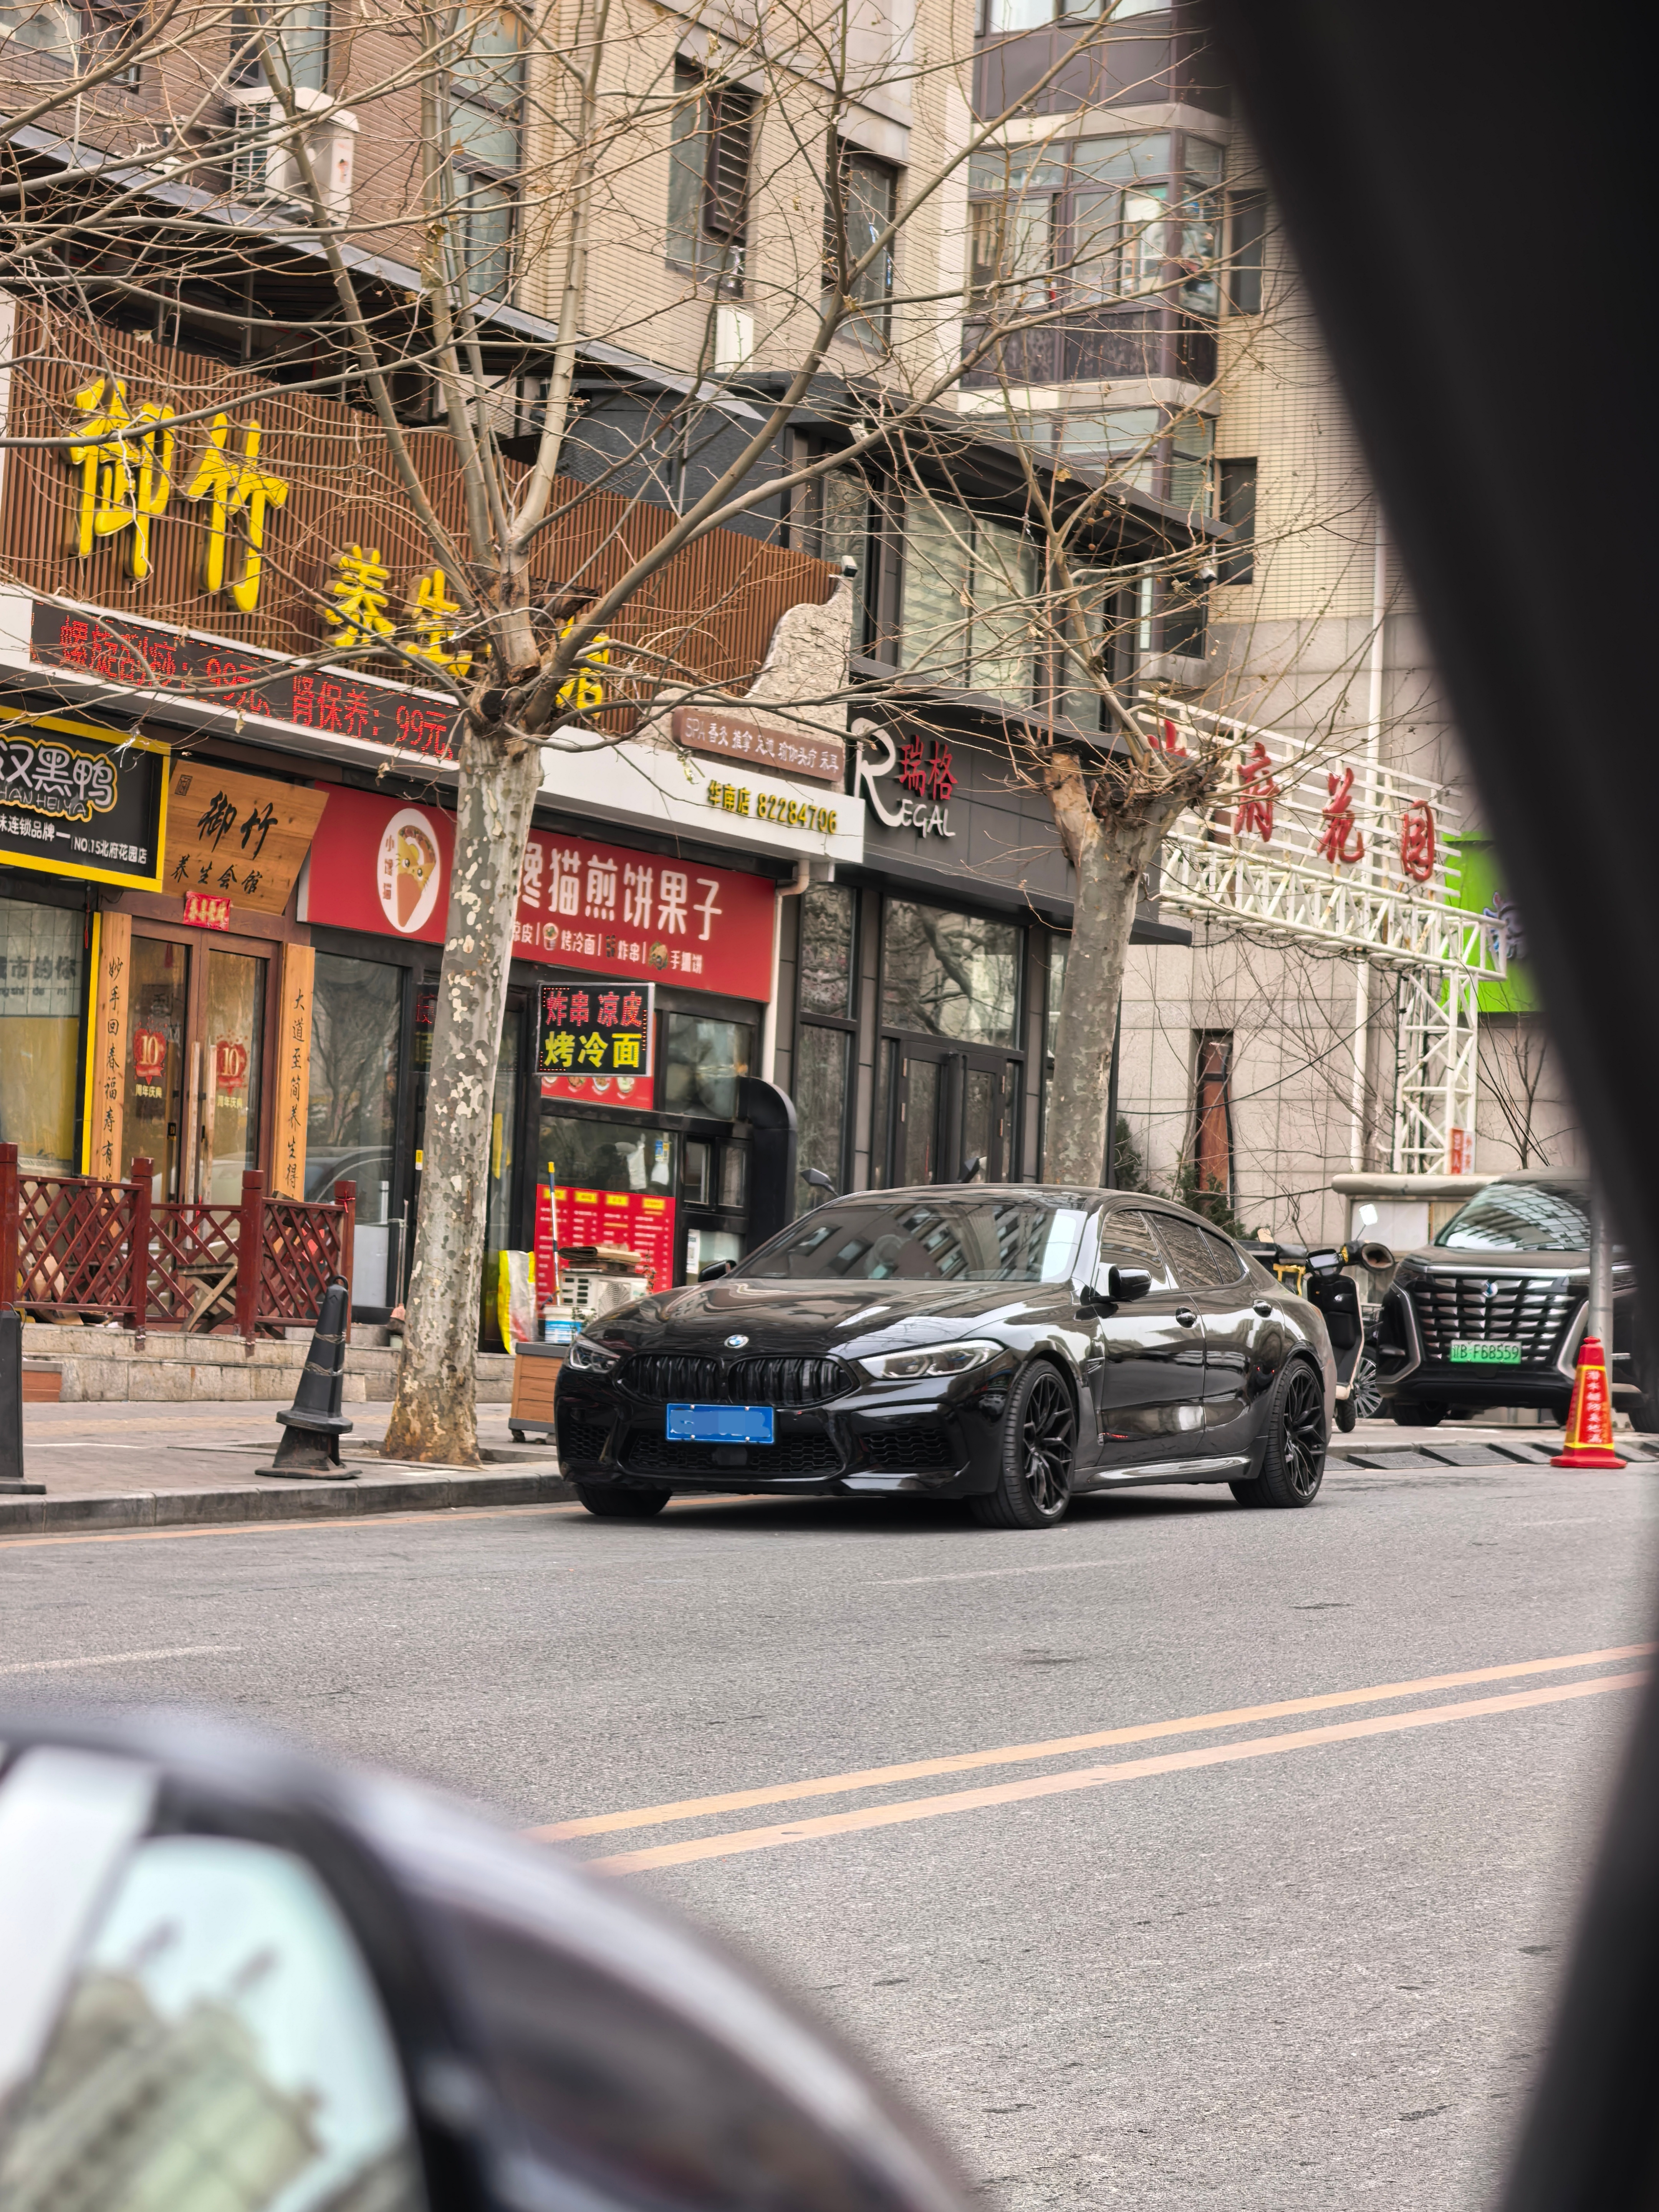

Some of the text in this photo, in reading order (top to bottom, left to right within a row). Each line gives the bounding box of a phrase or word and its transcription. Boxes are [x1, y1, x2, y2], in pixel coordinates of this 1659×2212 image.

[898, 734, 959, 801] 瑞格
[757, 793, 837, 834] 82284706
[171, 854, 263, 894] 养生会馆
[546, 990, 643, 1027] 炸串 凉皮
[140, 1035, 158, 1065] 10
[221, 1047, 240, 1076] 10
[543, 1031, 642, 1068] 烤冷面
[285, 988, 306, 1200] 大道至简养生得
